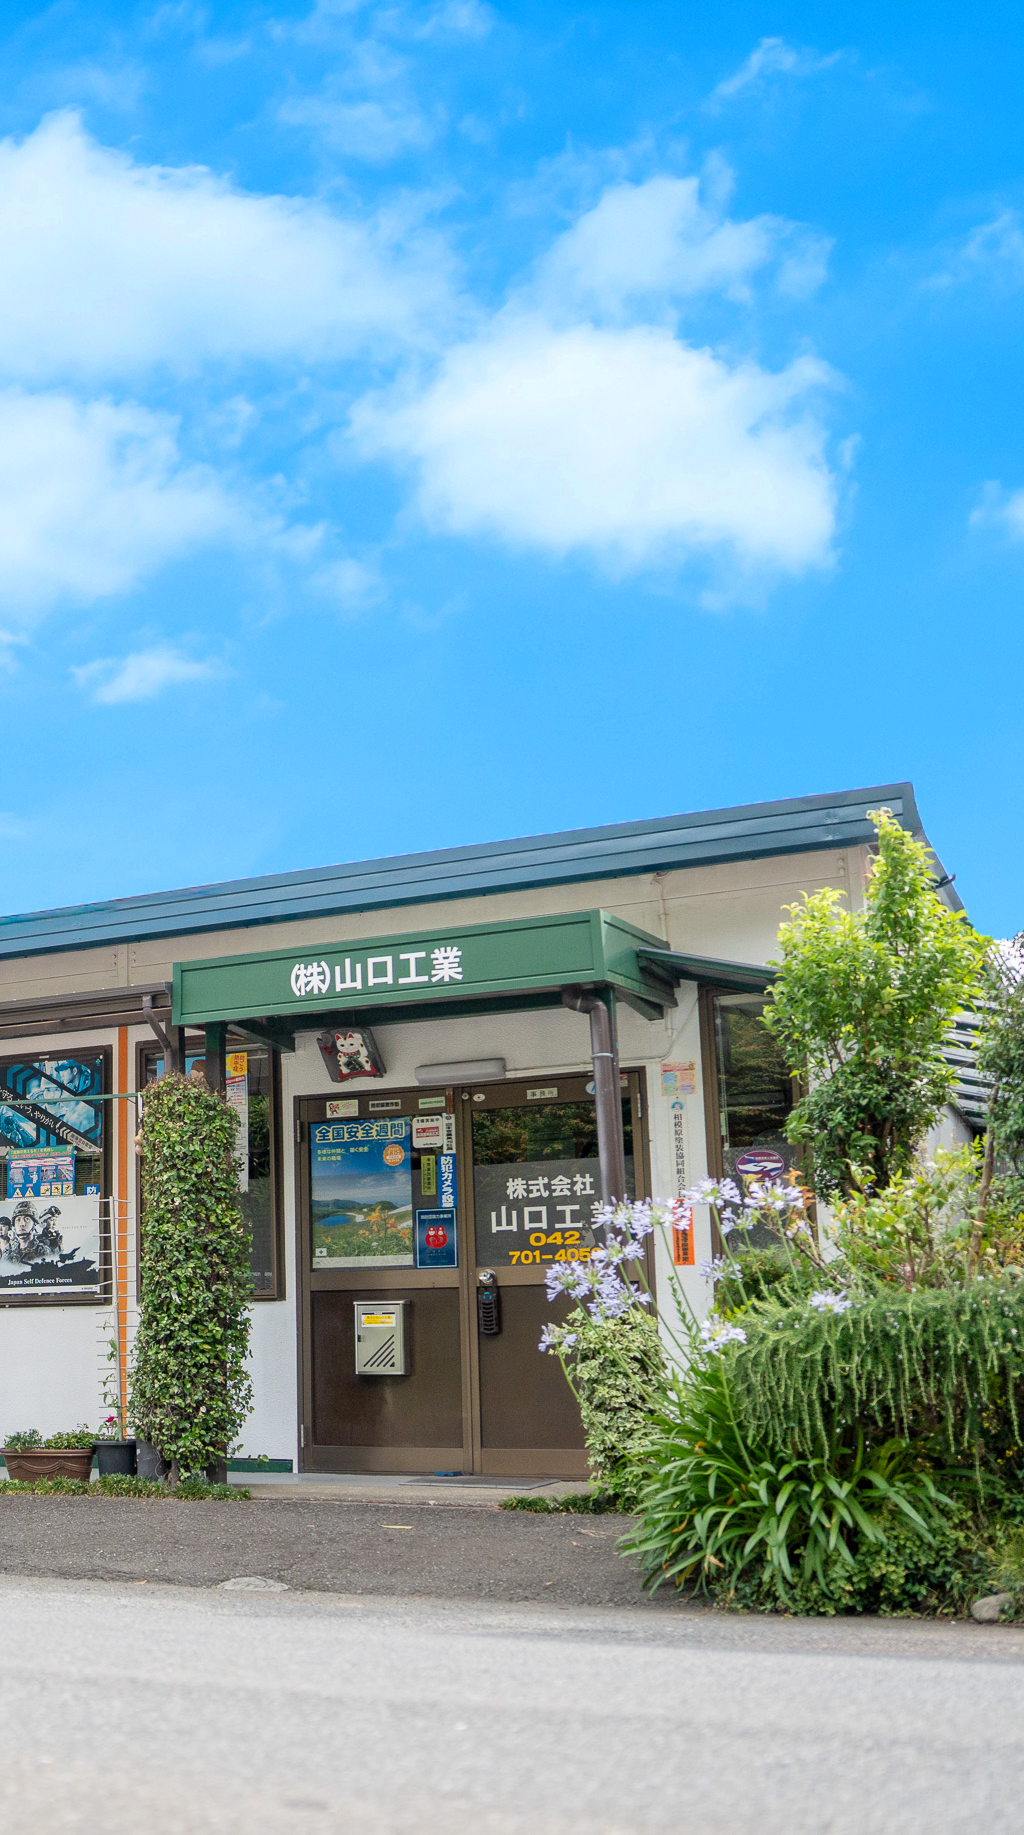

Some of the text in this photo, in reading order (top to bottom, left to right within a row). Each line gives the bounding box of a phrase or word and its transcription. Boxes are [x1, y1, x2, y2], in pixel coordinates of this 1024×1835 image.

[290, 946, 464, 997] (株)山口工業
[316, 1121, 405, 1143] 全国安全週間
[506, 1173, 595, 1200] 株式会社
[529, 1231, 581, 1247] 042
